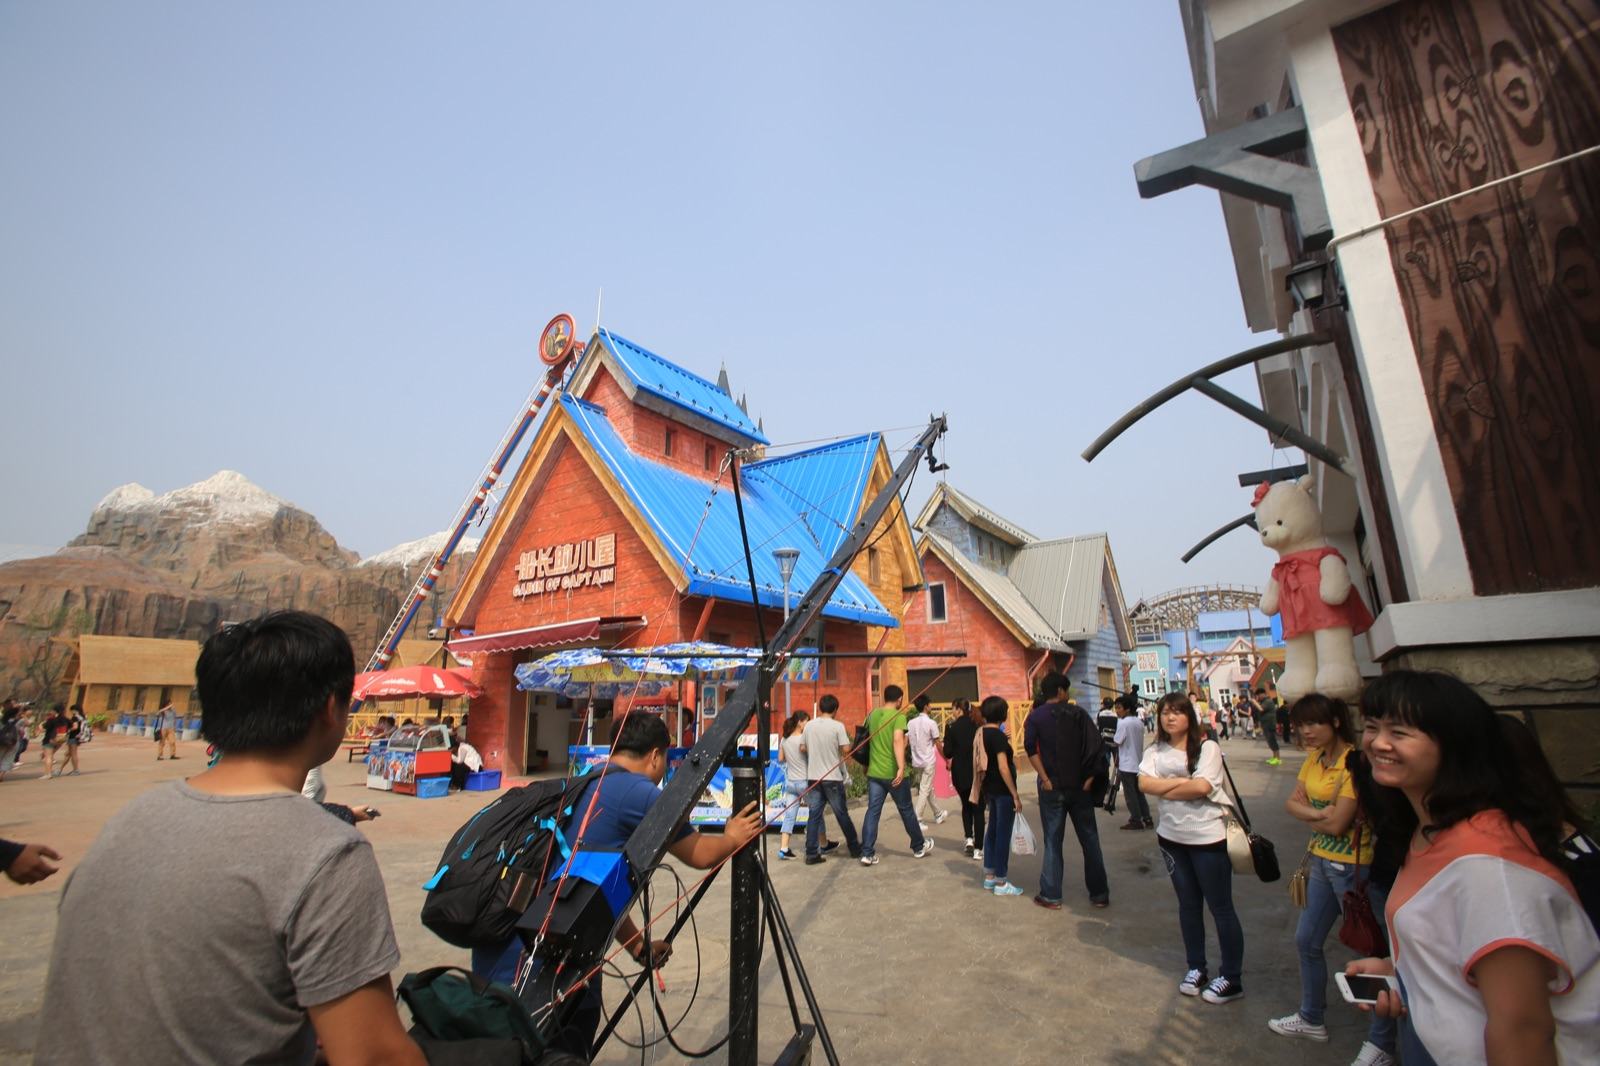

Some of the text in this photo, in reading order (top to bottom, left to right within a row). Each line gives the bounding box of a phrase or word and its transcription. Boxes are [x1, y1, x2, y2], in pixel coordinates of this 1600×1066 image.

[515, 533, 616, 580] 船长的小屋
[513, 567, 614, 597] CABIN OF CAPTAIN
